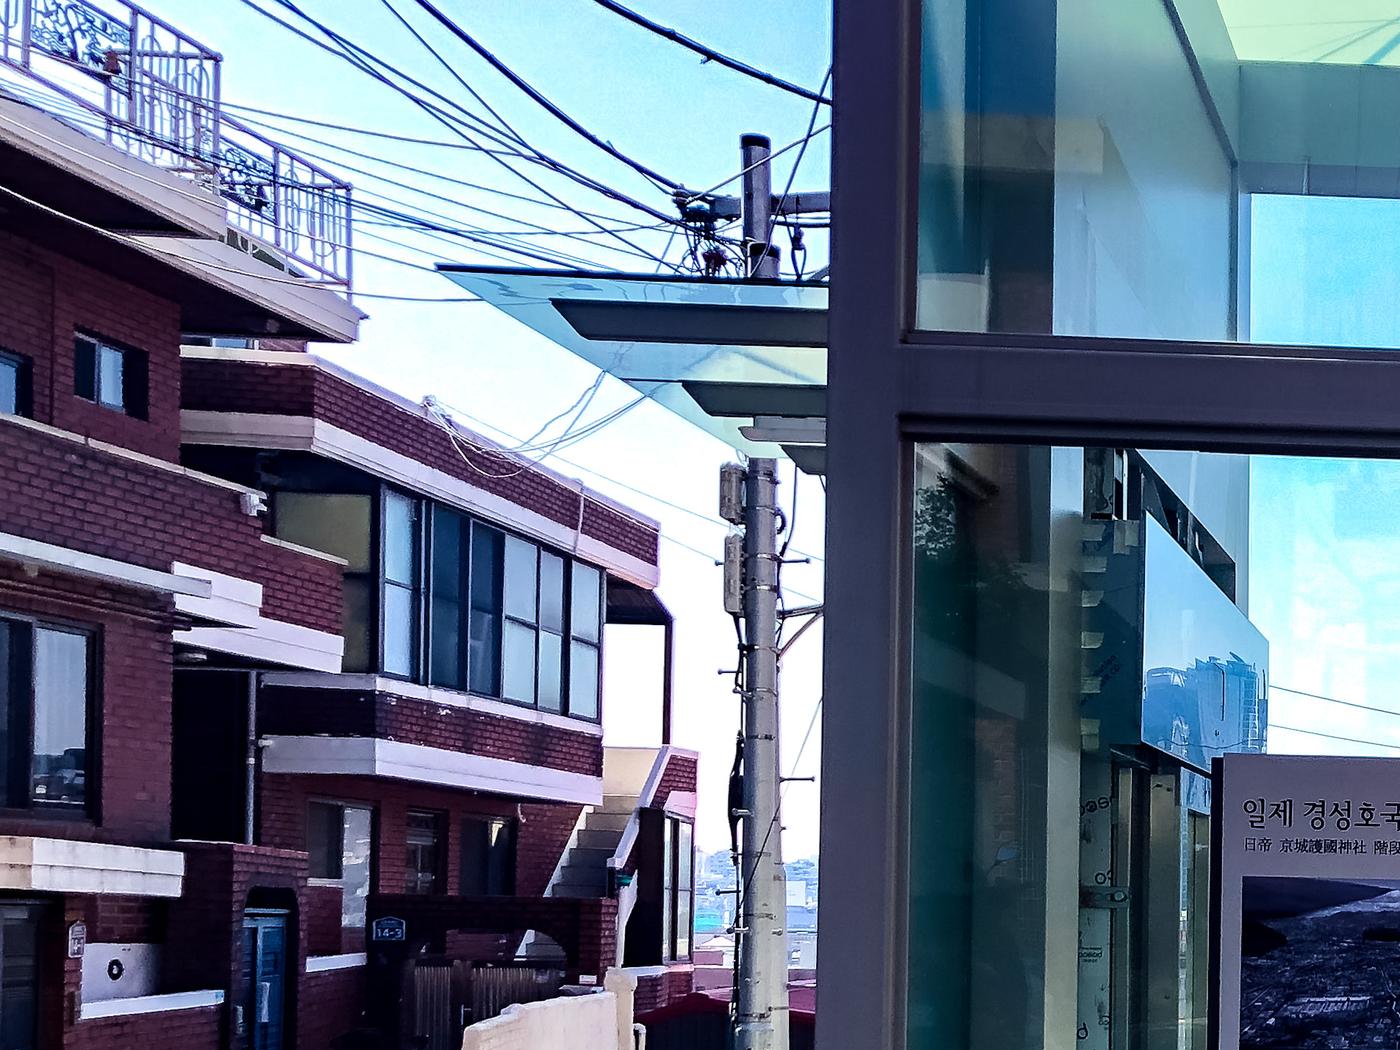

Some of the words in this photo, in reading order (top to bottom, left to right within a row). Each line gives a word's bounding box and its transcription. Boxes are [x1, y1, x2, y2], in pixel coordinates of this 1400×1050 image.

[1243, 797, 1292, 829] 일제
[1242, 836, 1272, 852] 日帝
[1279, 837, 1367, 855] 京城護國神社
